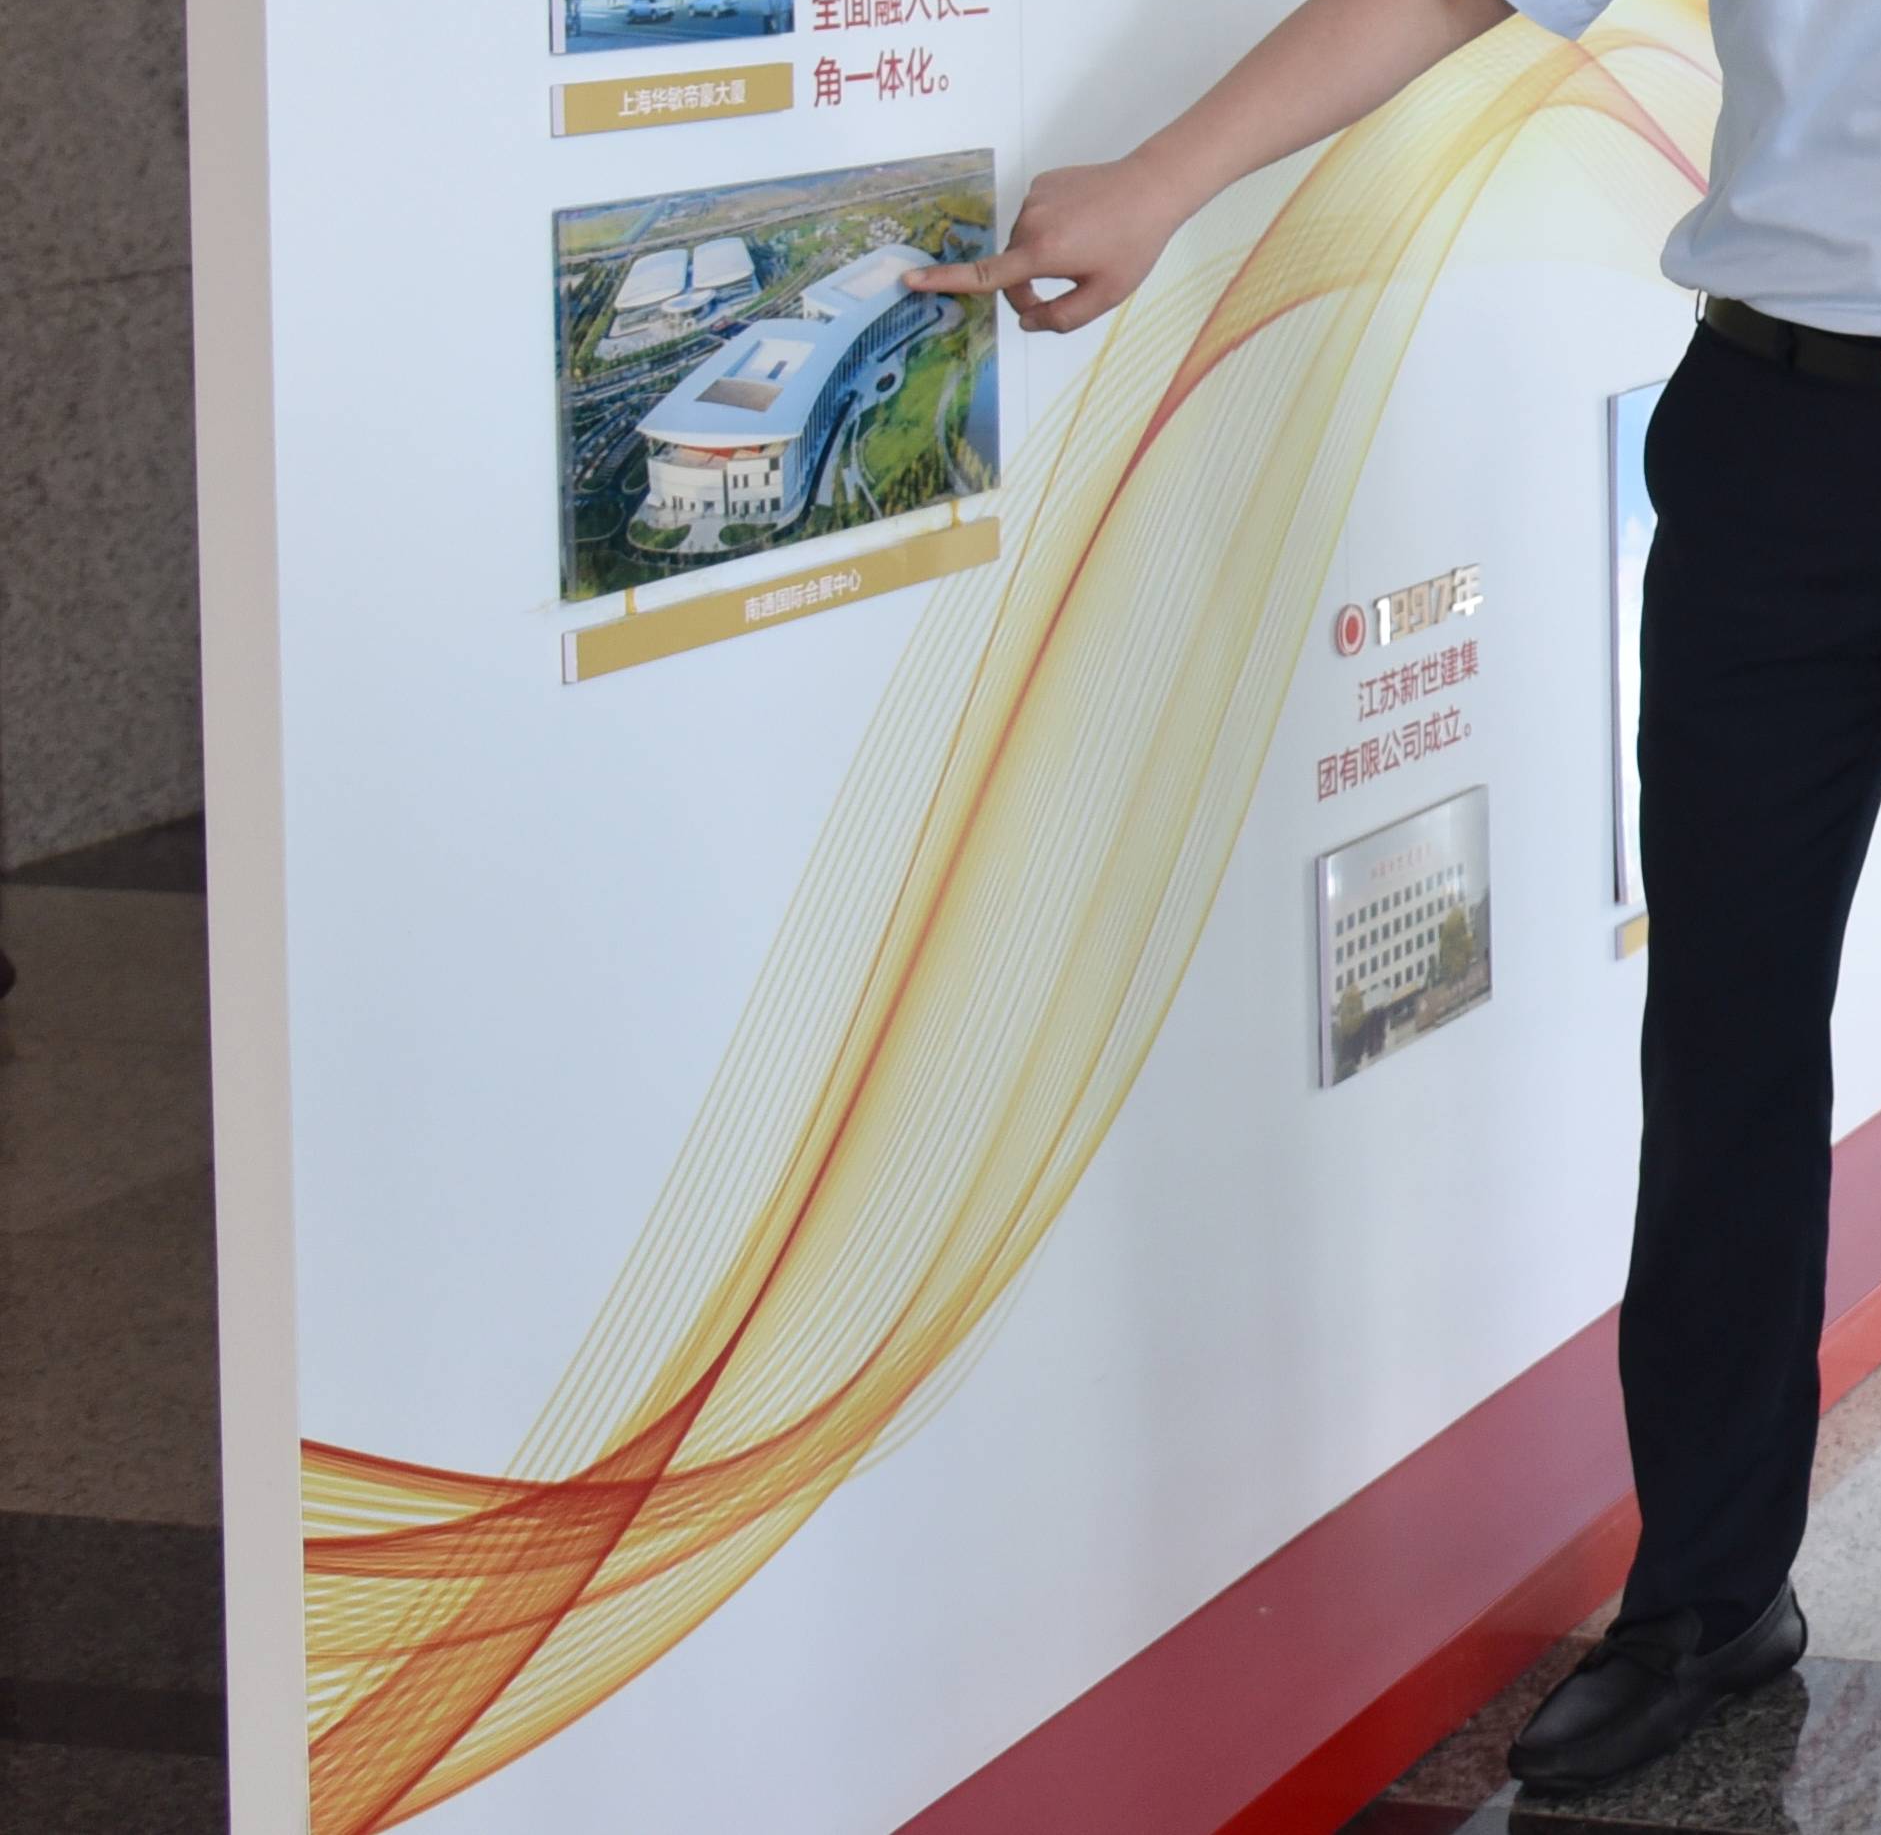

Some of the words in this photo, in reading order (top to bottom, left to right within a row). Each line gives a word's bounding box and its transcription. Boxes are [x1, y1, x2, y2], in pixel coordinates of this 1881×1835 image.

[812, 46, 951, 109] 角一体化。
[1373, 564, 1483, 647] 1997年
[1358, 638, 1480, 723] 江苏新世建集
[1317, 705, 1472, 803] 团有限公司成立。
